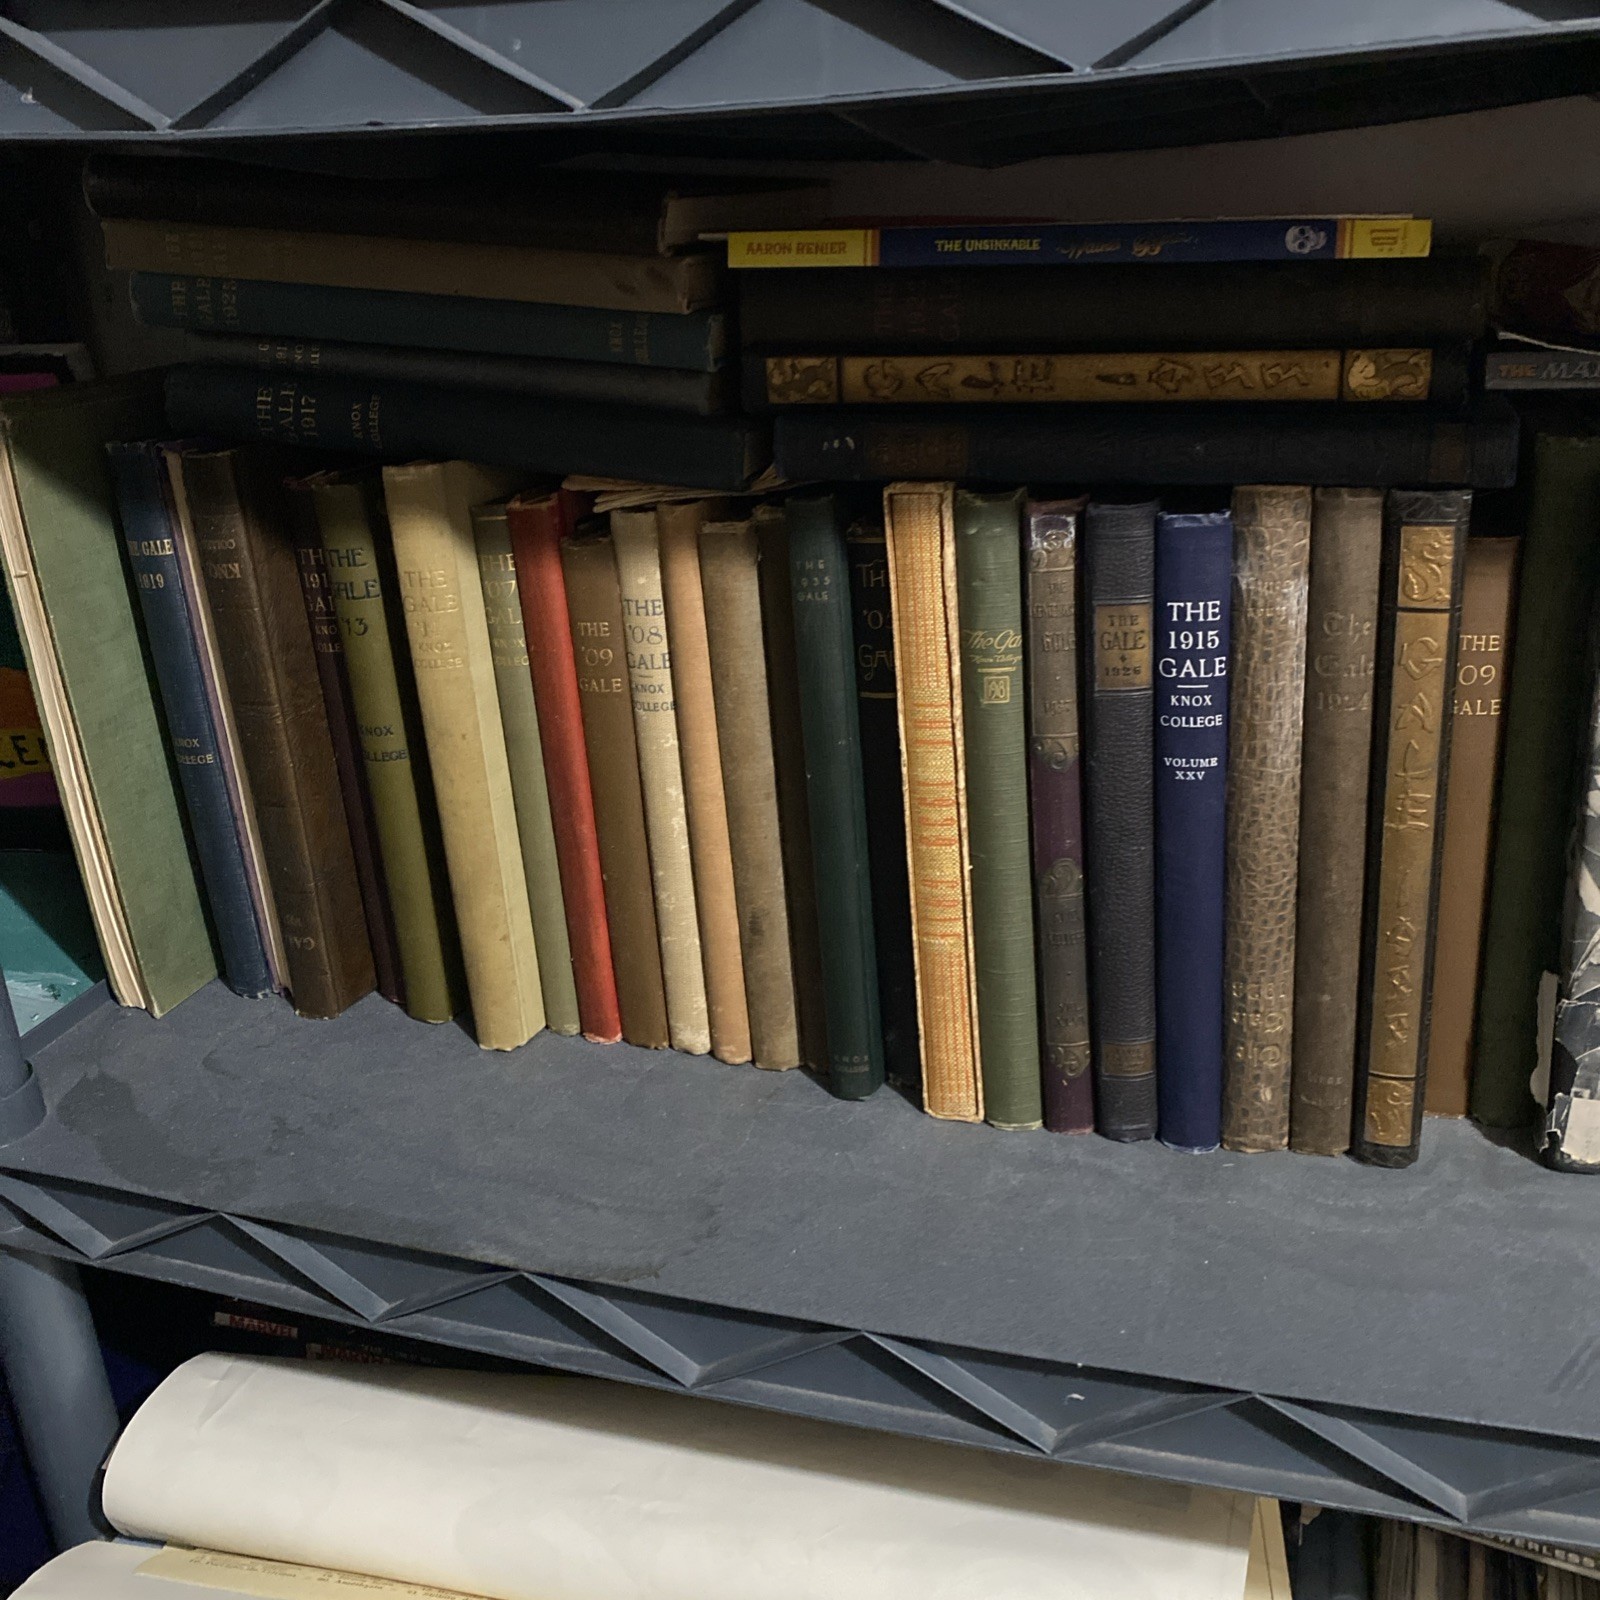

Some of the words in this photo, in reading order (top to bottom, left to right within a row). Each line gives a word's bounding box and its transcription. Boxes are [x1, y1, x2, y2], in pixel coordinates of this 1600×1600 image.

[746, 242, 792, 256] AARON
[796, 241, 847, 255] RENIER
[935, 239, 961, 252] THE
[964, 238, 1041, 252] UNSINKABLE
[301, 395, 317, 439] 1917
[141, 538, 174, 557] GALE
[403, 570, 448, 589] THE
[403, 594, 460, 615] GALE
[623, 599, 663, 617] THE
[1166, 600, 1221, 622] THE
[577, 621, 611, 638] THE
[1107, 614, 1140, 628] THE
[627, 624, 664, 645] '08
[1101, 630, 1146, 651] GALE
[1168, 630, 1220, 650] 1915
[1459, 634, 1500, 652] THE
[581, 646, 614, 667] '09
[626, 653, 672, 671] GALE
[1105, 665, 1142, 677] 1926
[1158, 656, 1227, 678] GALE
[580, 677, 623, 693] GALE
[631, 683, 664, 694] KNOX
[1170, 694, 1212, 707] KNOX
[1160, 714, 1223, 728] COLLEGE
[1163, 757, 1219, 768] VOLUME
[1175, 770, 1205, 781] XXV
